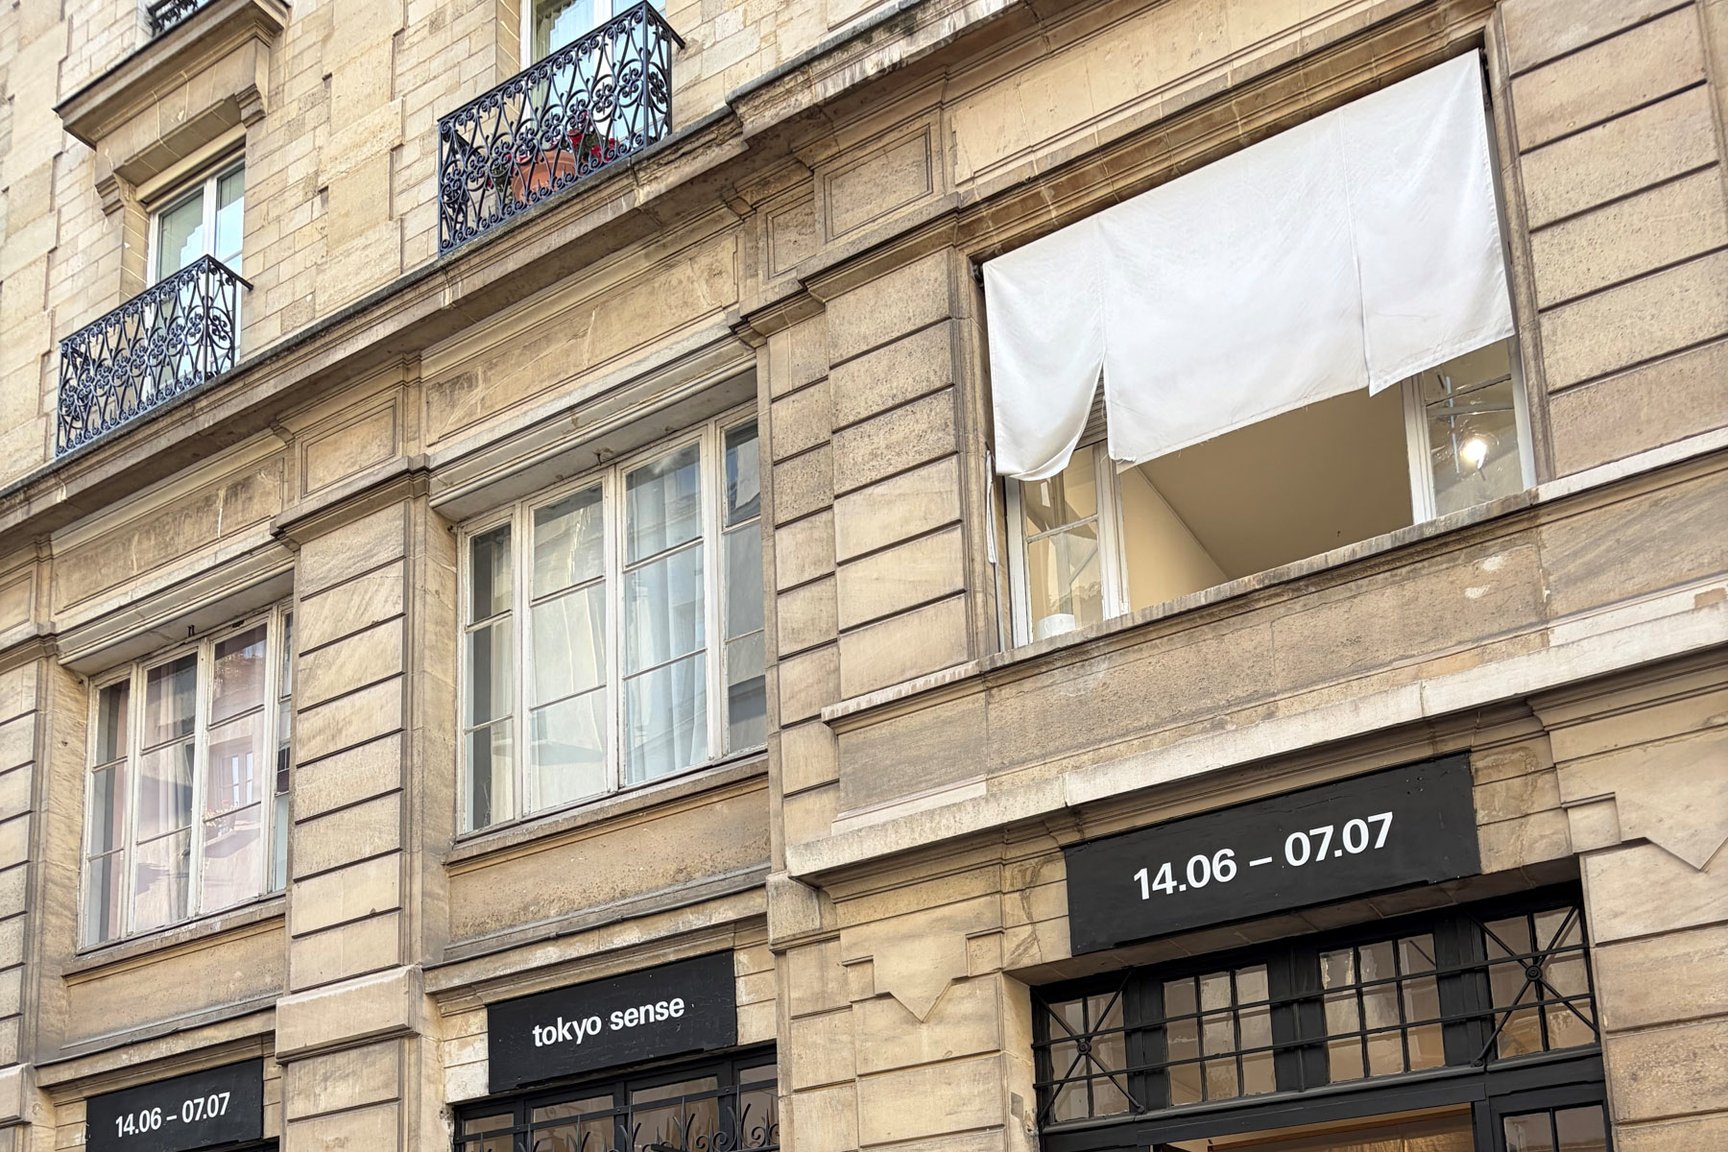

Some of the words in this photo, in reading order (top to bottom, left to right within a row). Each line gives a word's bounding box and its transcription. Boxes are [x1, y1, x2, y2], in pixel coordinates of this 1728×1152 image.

[1133, 847, 1237, 900] 14.06
[1284, 811, 1394, 867] 07.07
[532, 1015, 602, 1047] tokyo
[610, 997, 685, 1031] sense
[115, 1107, 162, 1138] 14.06
[182, 1091, 231, 1124] 07.07
